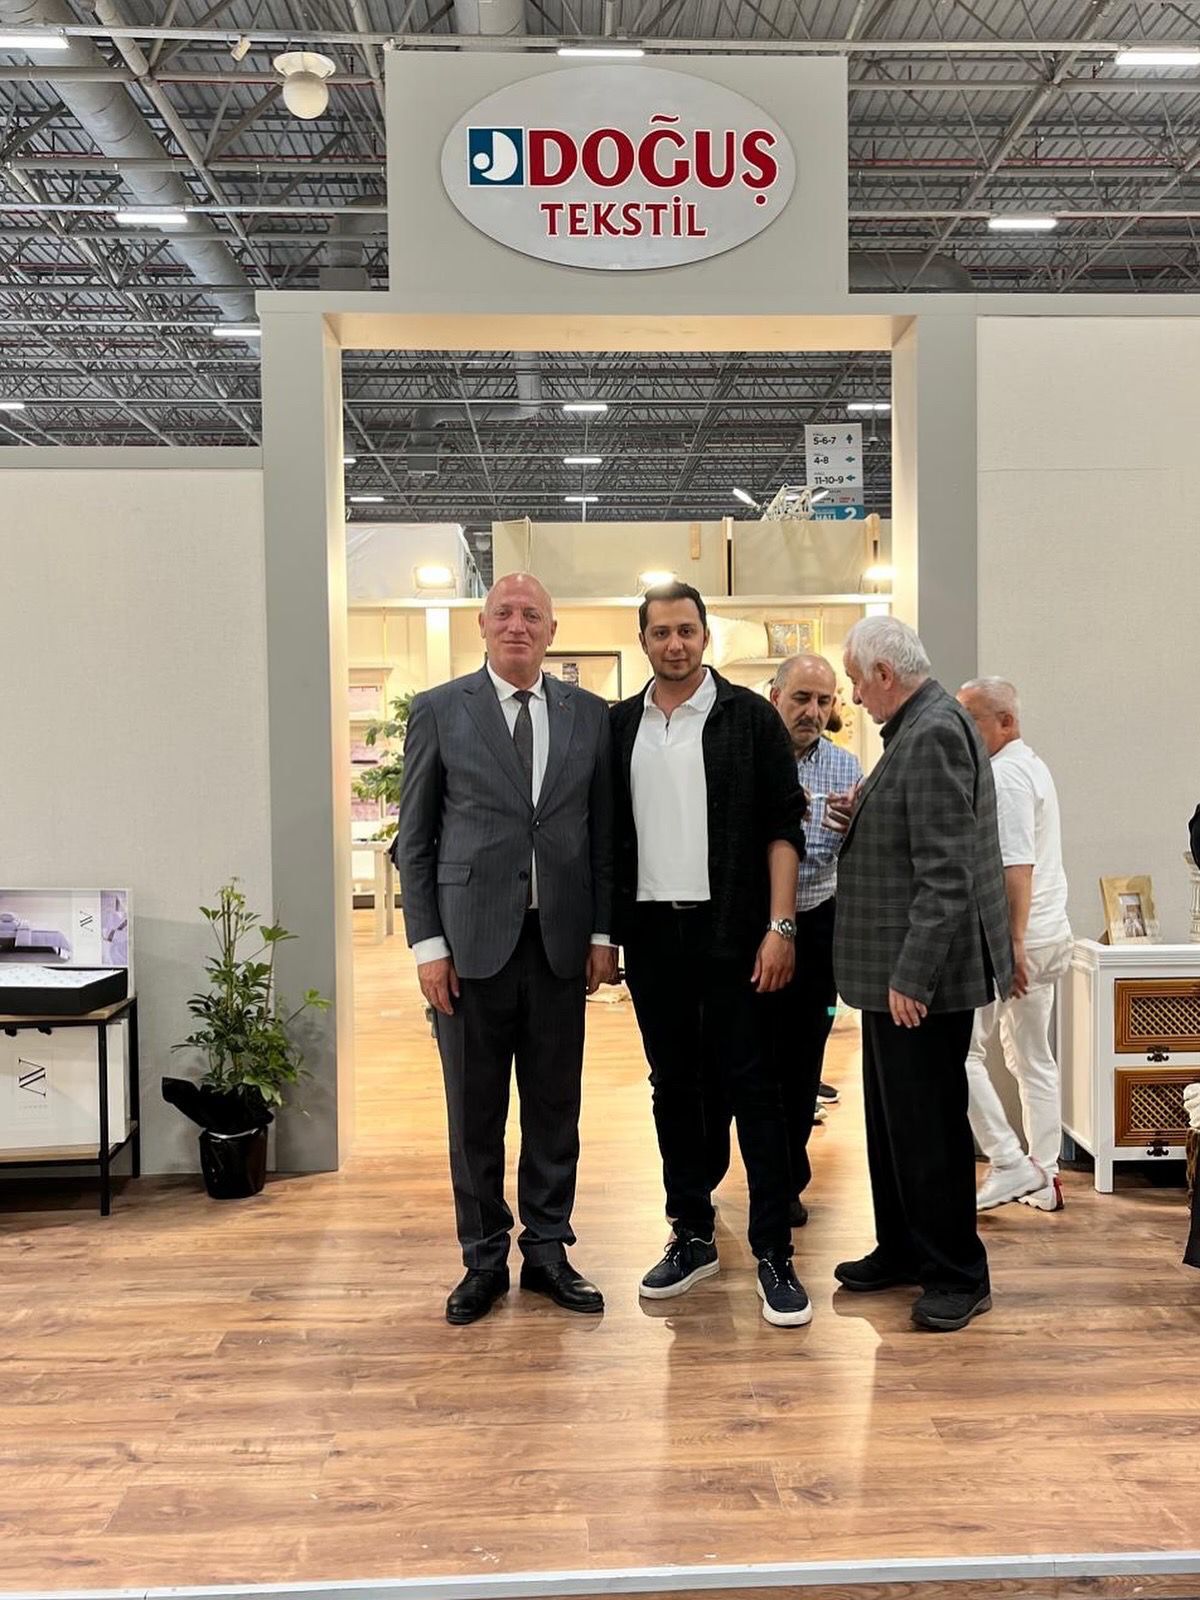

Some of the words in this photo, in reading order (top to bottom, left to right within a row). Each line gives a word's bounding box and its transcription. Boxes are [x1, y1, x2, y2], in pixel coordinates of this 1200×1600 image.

[528, 114, 778, 206] DOĞUŞ
[541, 196, 708, 238] TEKSTİL
[813, 437, 836, 445] 5-6-7
[814, 476, 844, 484] 11-10-9
